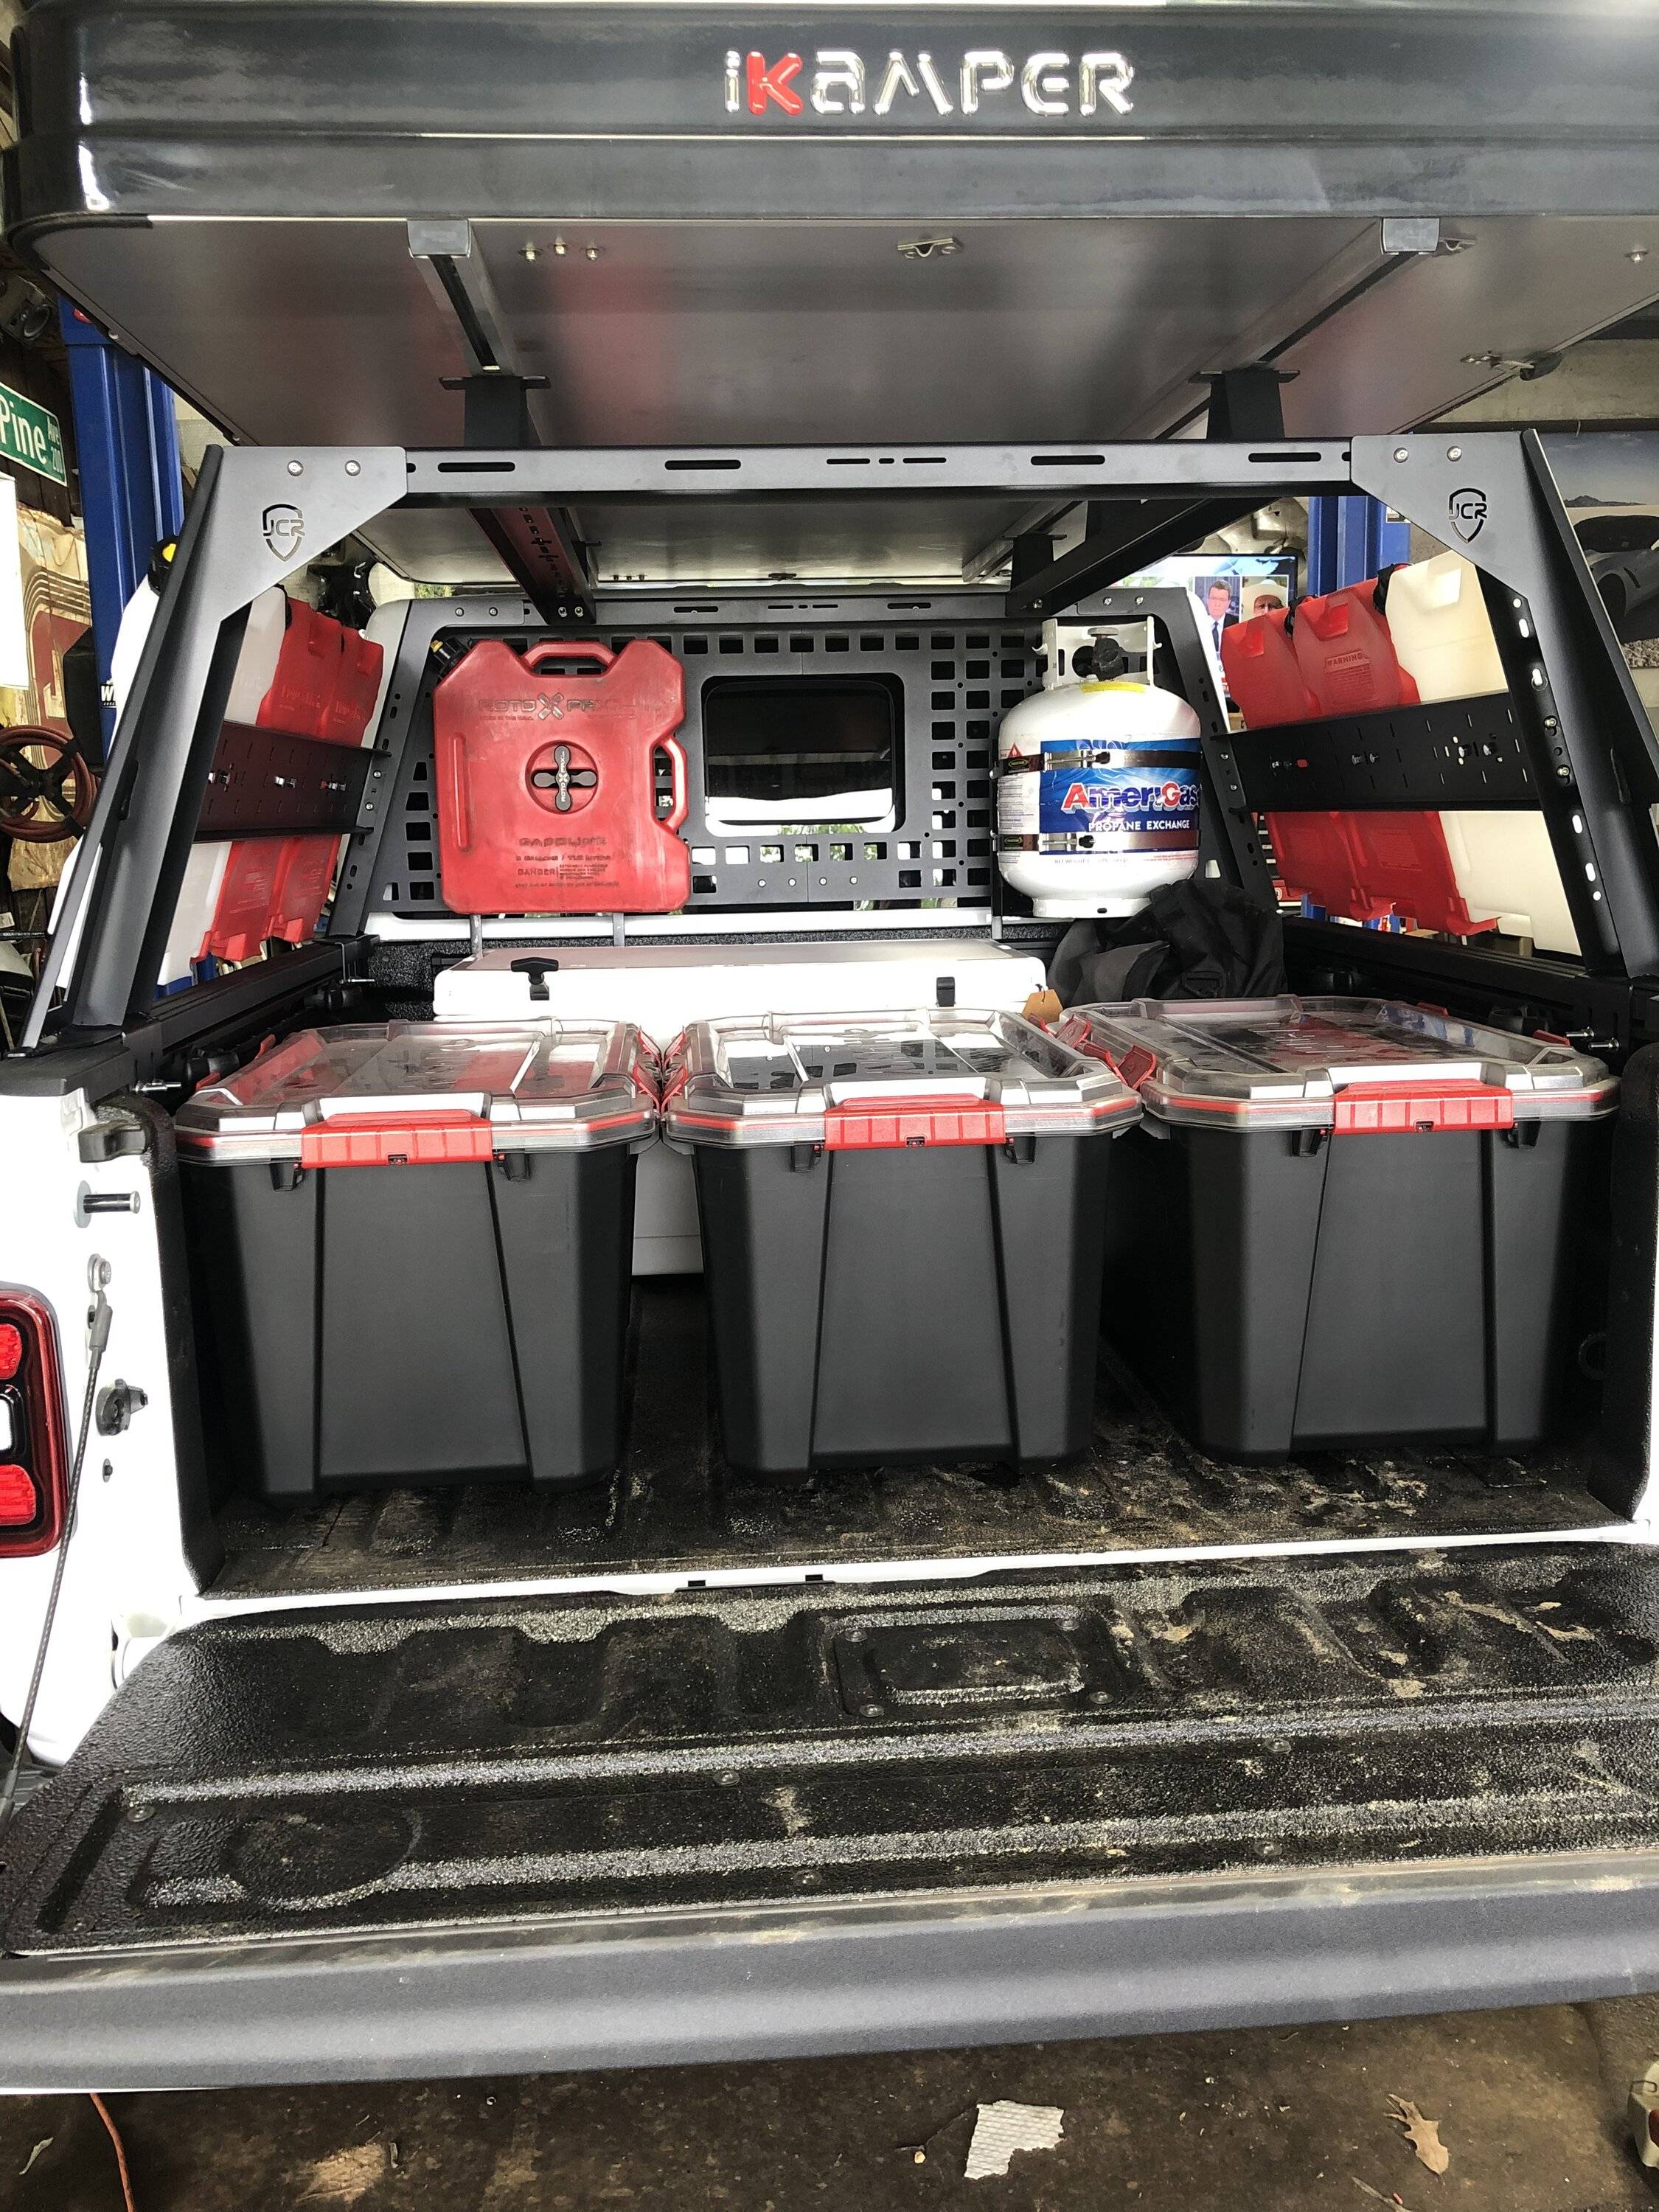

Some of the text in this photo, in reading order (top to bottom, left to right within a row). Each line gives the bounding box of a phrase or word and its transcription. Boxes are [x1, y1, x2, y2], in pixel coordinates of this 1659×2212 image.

[0, 393, 46, 465] Pine
[1449, 503, 1487, 519] JCR
[263, 519, 305, 537] JCR
[1088, 819, 1190, 833] PROPANE EXCHANGE
